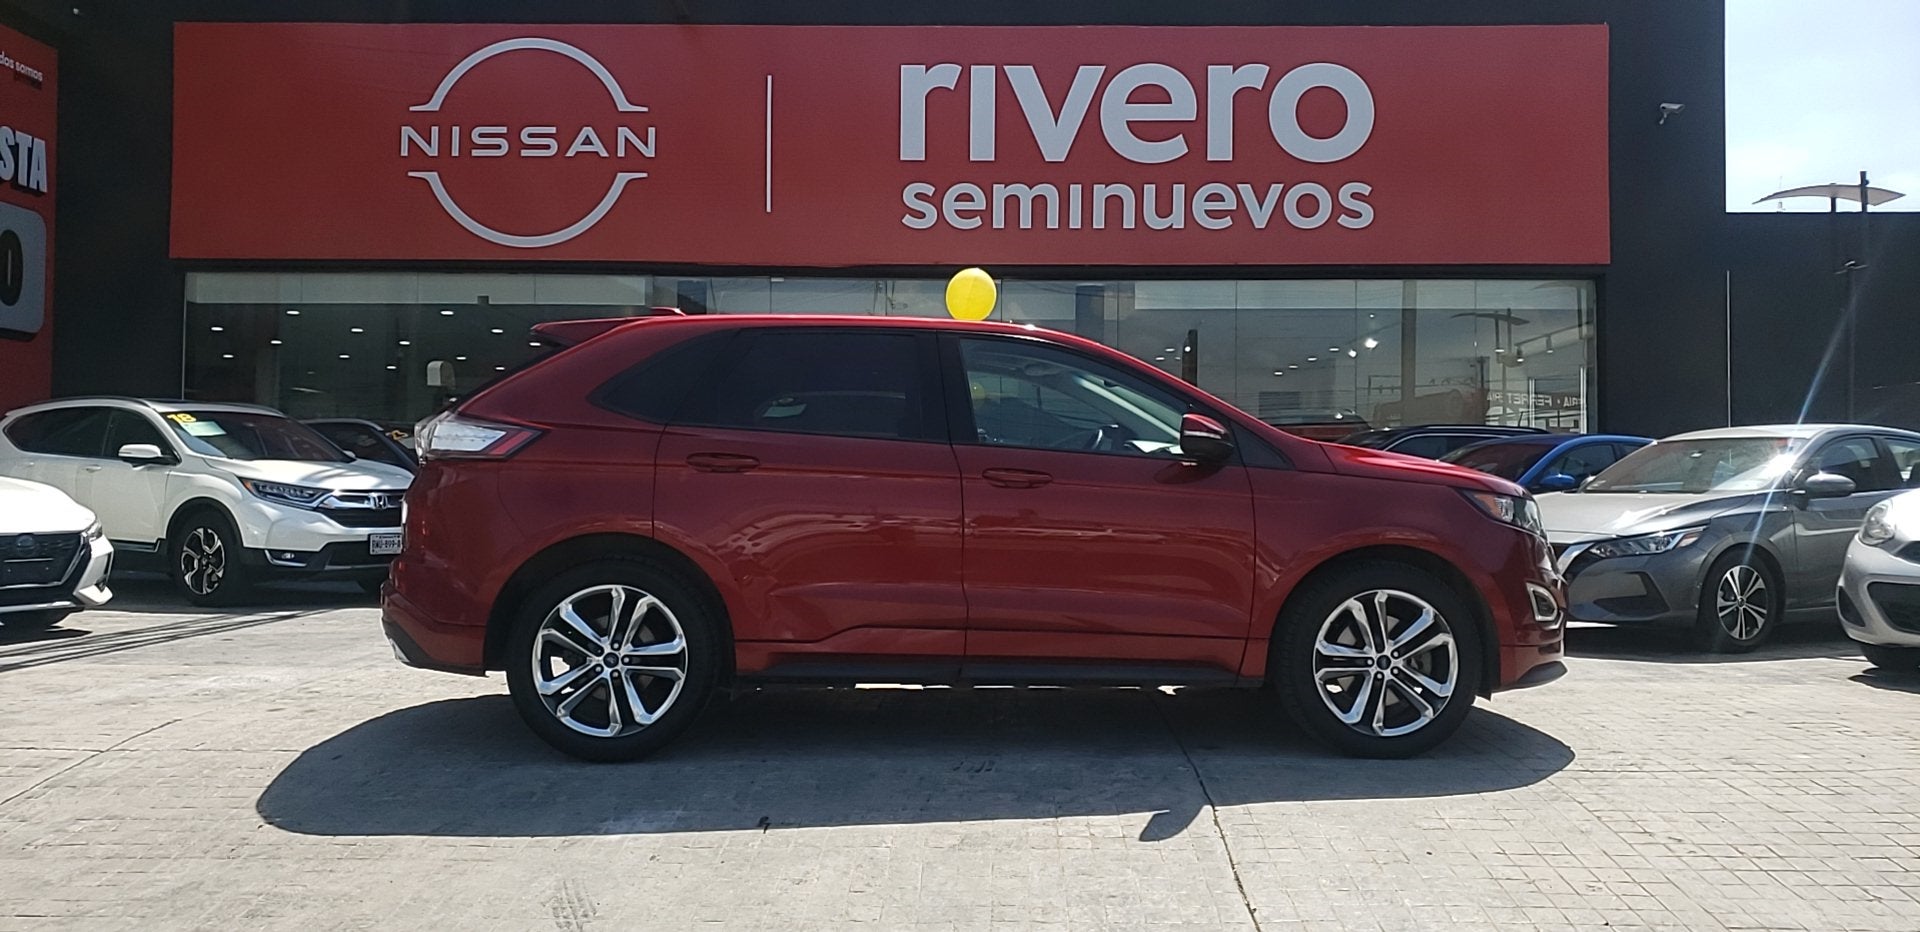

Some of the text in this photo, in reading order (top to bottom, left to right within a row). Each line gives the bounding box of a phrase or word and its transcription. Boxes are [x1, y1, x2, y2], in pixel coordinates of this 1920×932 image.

[15, 61, 43, 81] somos
[899, 62, 1375, 164] rivero
[0, 126, 47, 193] STA
[400, 125, 656, 158] NISSAN
[901, 182, 1375, 230] seminuevos
[166, 413, 197, 424] 18
